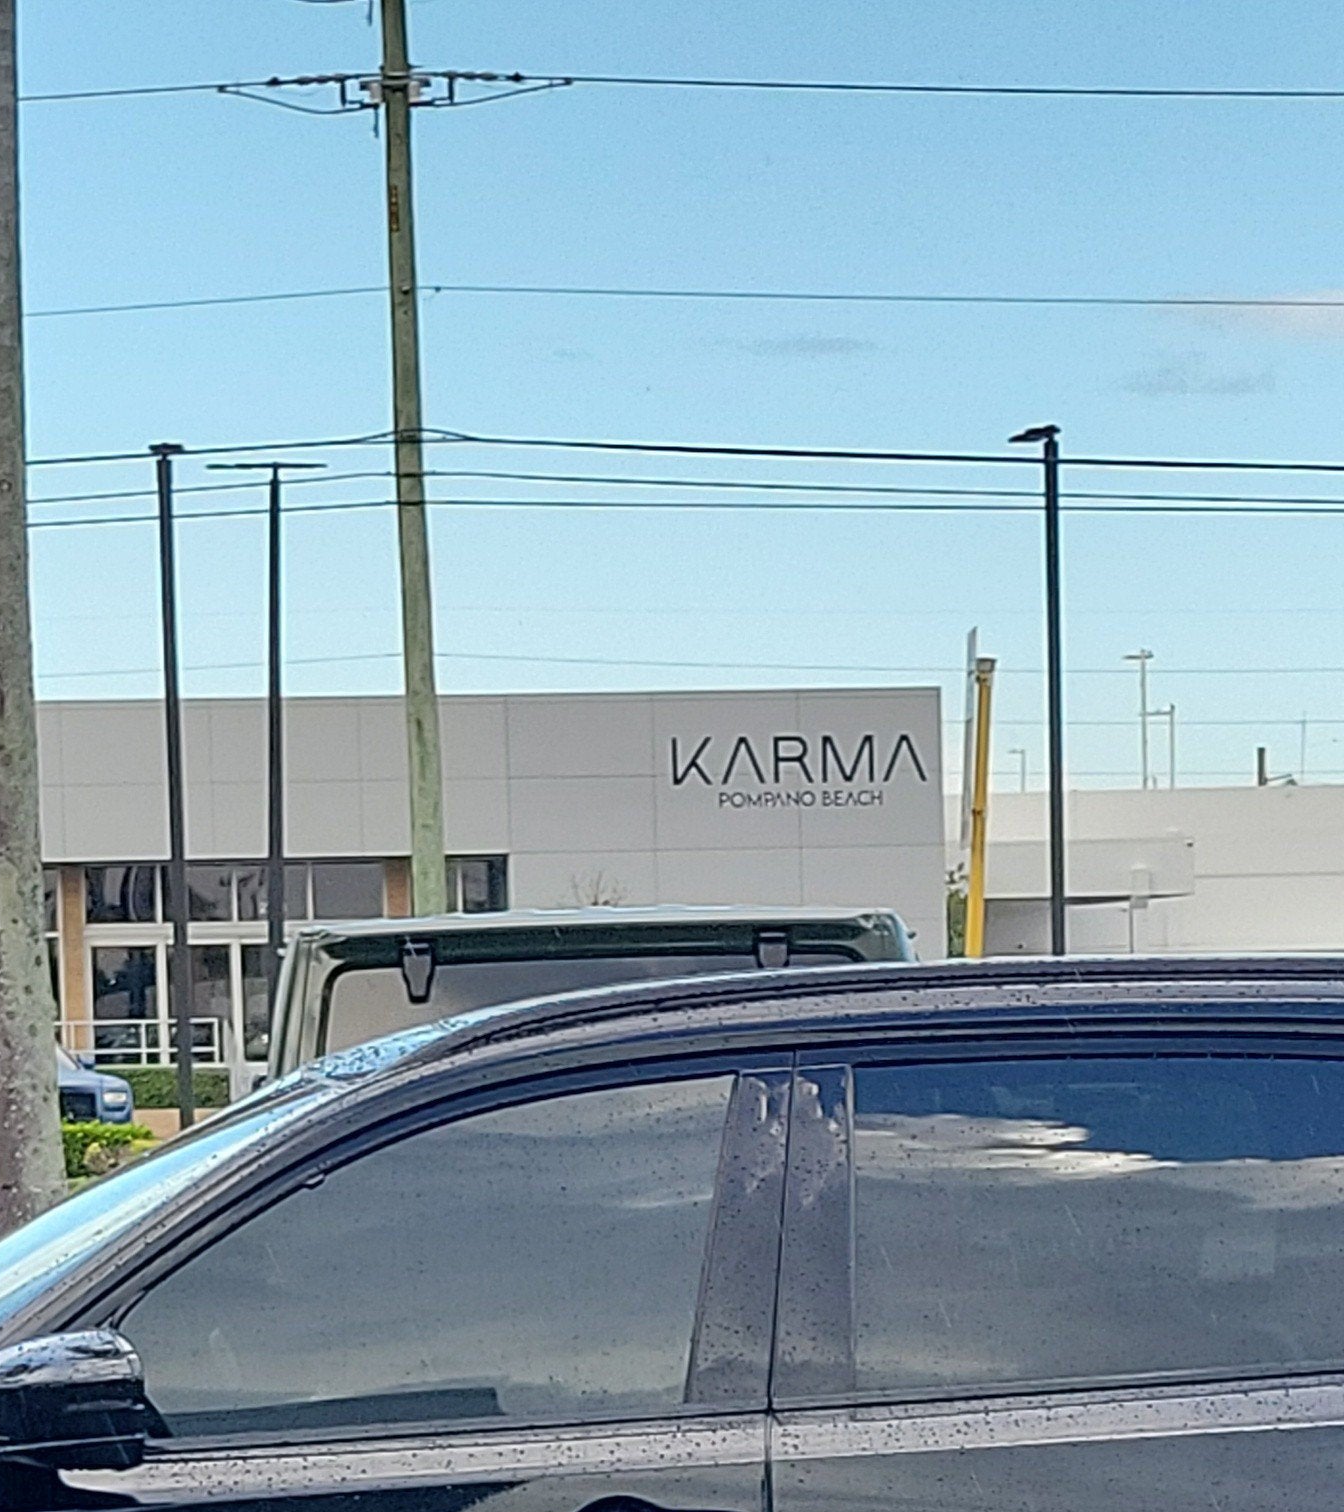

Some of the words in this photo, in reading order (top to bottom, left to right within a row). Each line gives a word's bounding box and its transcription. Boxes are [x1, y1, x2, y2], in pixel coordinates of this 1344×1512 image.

[670, 734, 928, 786] KARMA
[718, 790, 816, 808] POMPANO
[821, 789, 884, 807] BEACH
